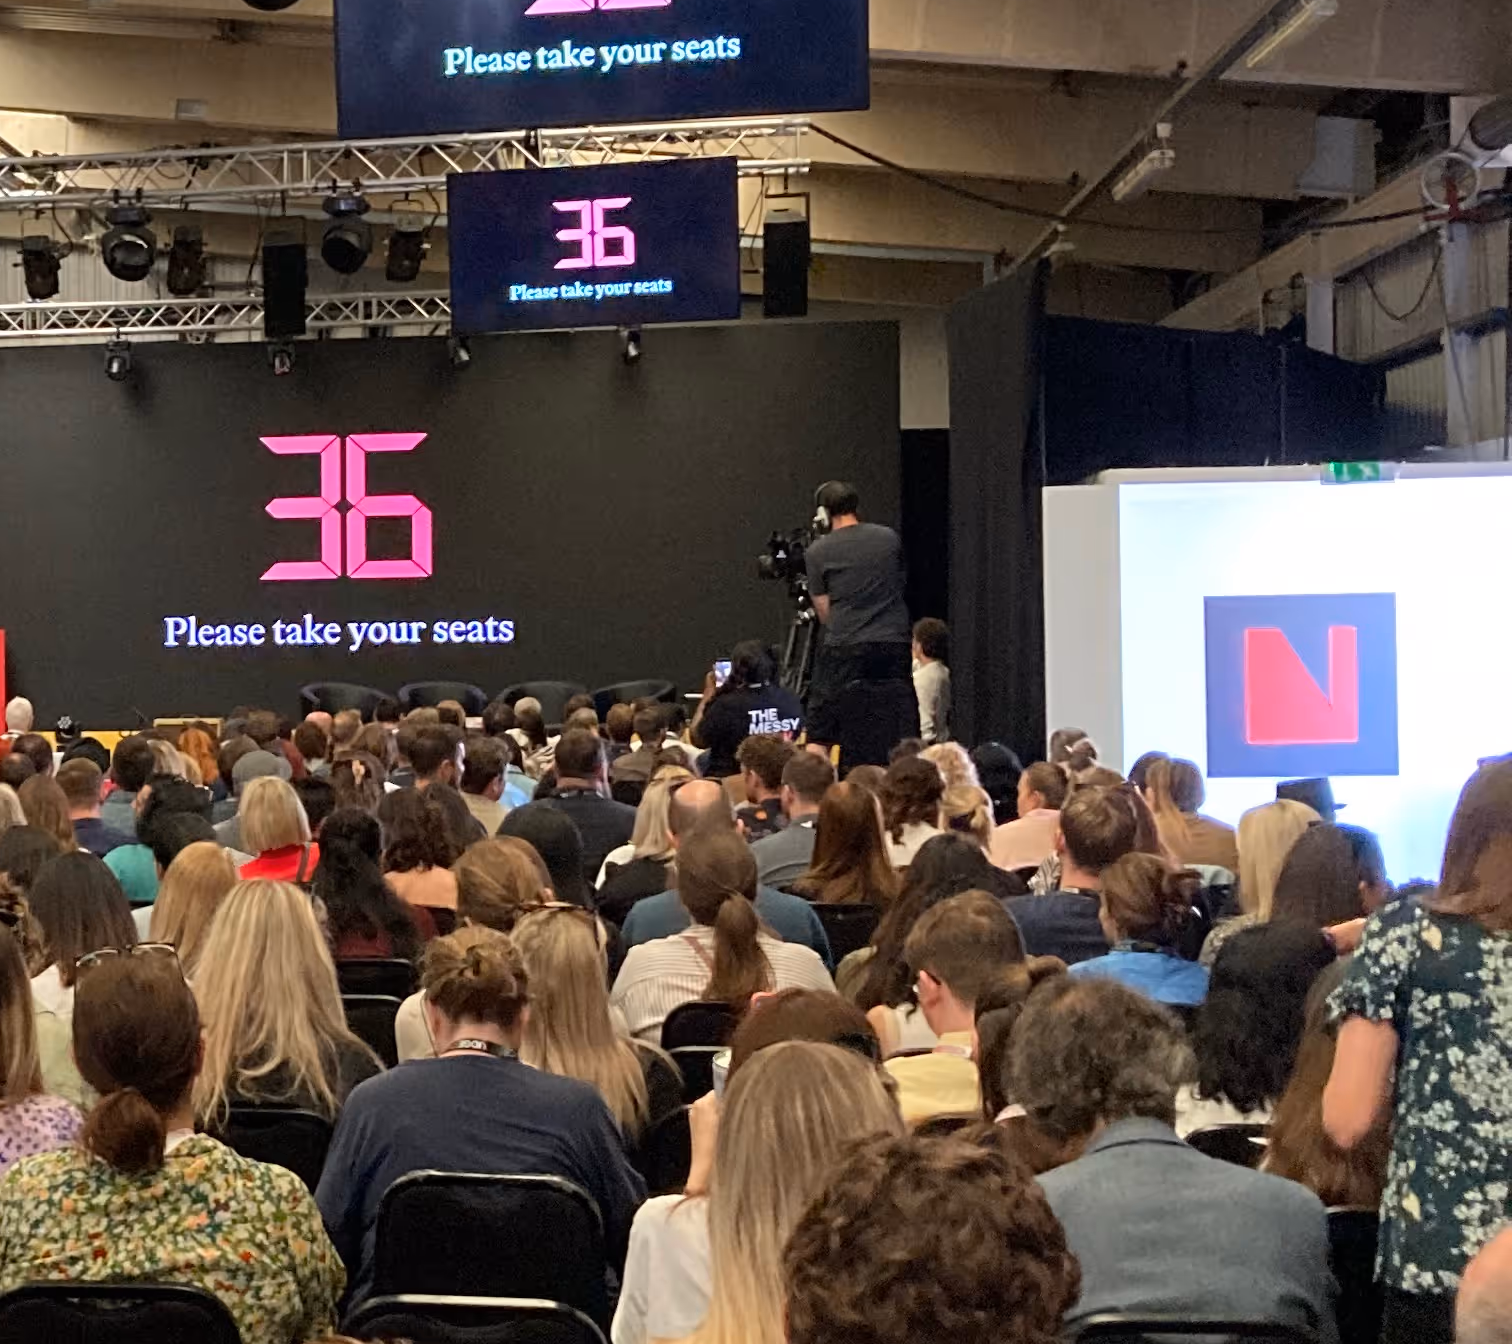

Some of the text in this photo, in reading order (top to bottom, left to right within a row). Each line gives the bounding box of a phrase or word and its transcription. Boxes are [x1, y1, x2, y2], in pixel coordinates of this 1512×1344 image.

[444, 35, 741, 75] Please take your seats
[553, 197, 636, 269] 36
[509, 278, 673, 301] Please take your seats
[259, 432, 433, 581] 36
[163, 613, 515, 652] Please take your seats
[1244, 624, 1359, 745] N
[748, 707, 779, 723] THE
[749, 717, 800, 735] MESSY
